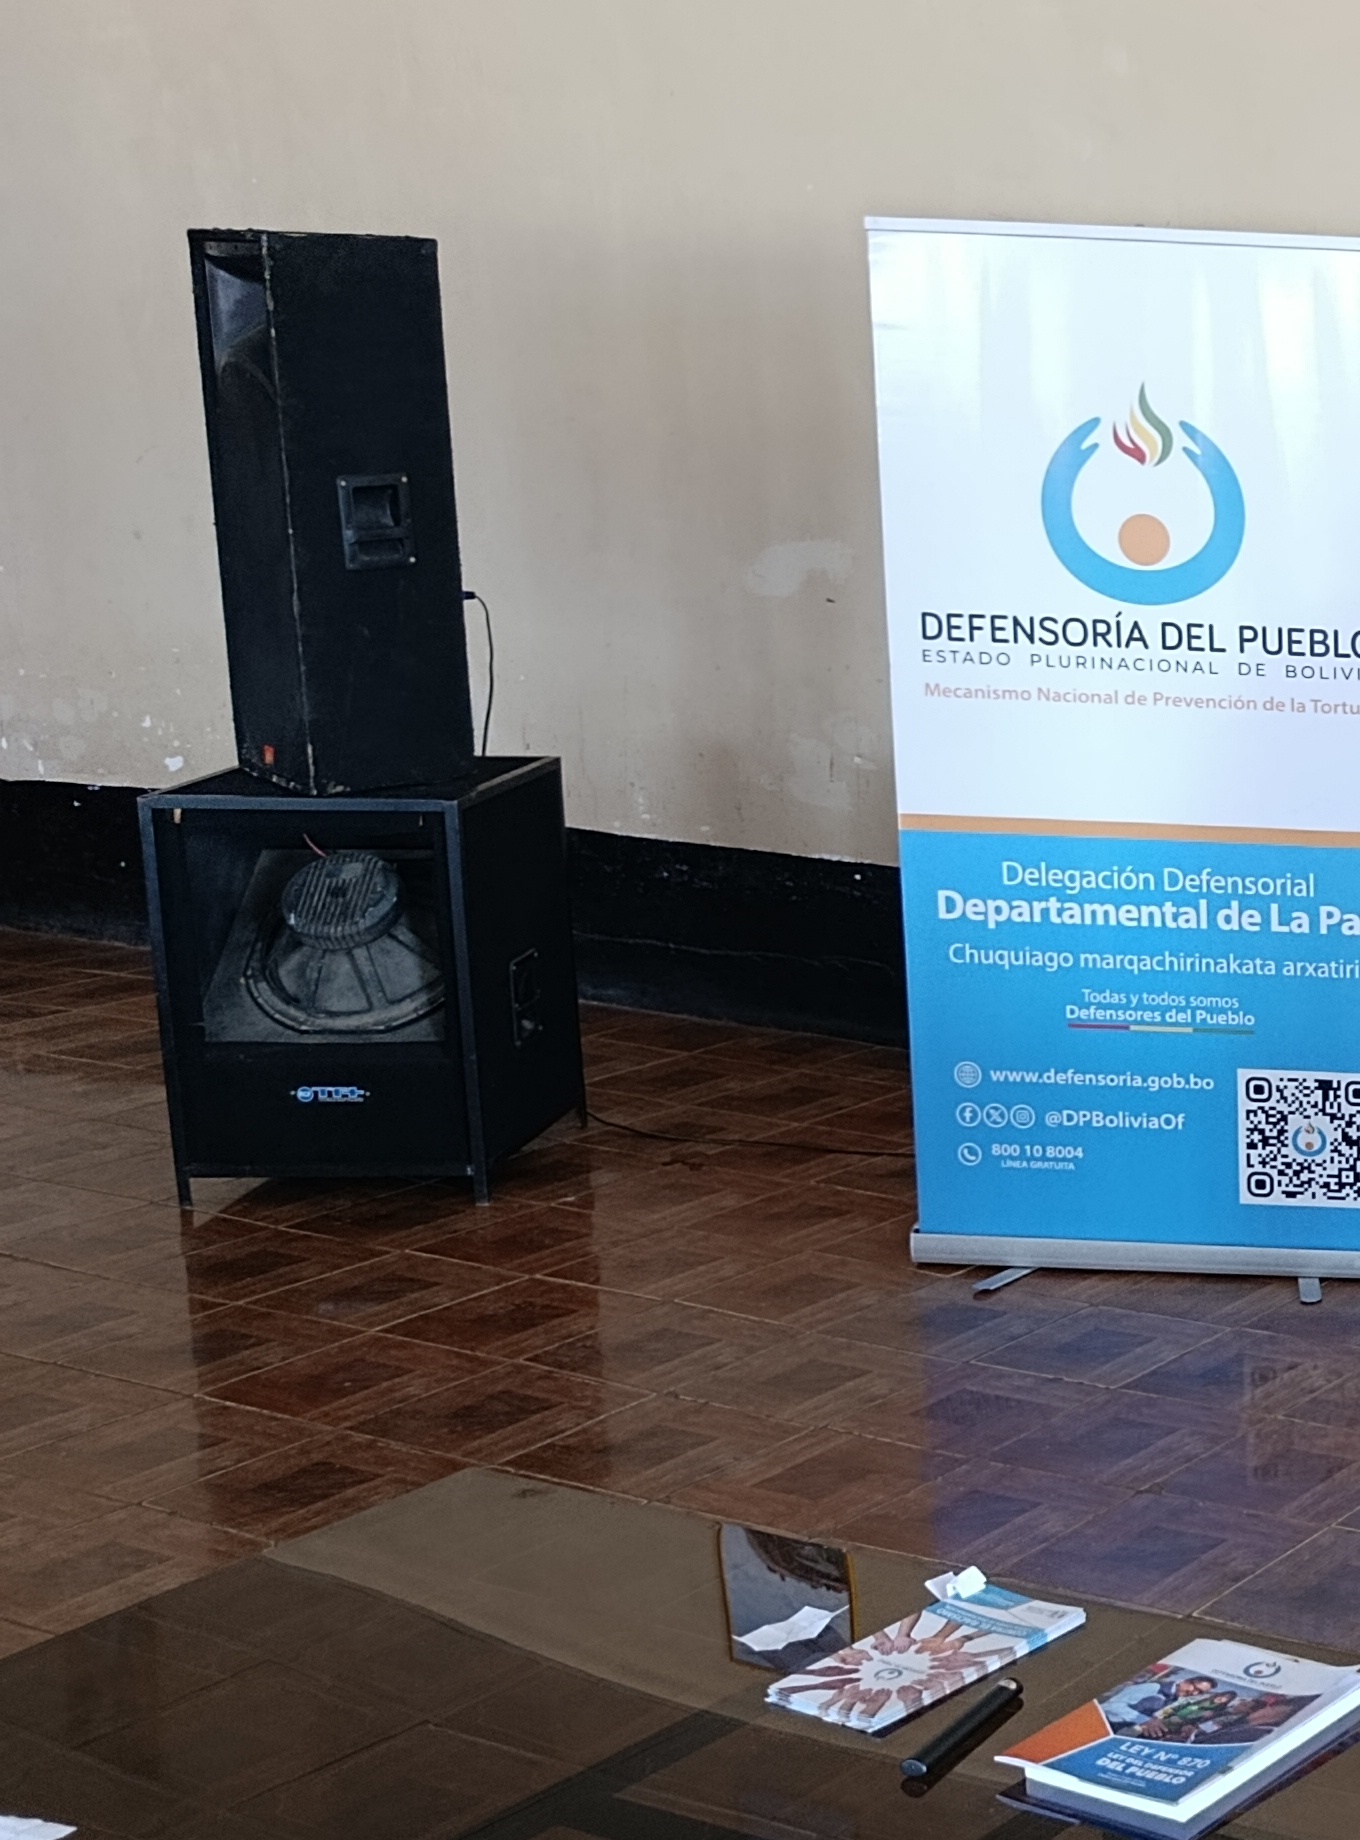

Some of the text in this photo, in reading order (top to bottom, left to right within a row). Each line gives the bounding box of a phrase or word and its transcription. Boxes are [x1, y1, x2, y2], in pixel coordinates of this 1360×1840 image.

[921, 611, 1149, 649] DEFENSORÍA
[1161, 621, 1227, 653] DEL
[922, 649, 1011, 666] ESTADO
[1030, 653, 1219, 675] PLURINACIONAL
[1238, 662, 1266, 677] DE
[924, 682, 1032, 701] Mecanismo
[1037, 687, 1118, 705] Nacional
[1124, 690, 1147, 706] de
[1153, 692, 1258, 711] Prevención
[1262, 697, 1286, 713] de
[1291, 698, 1306, 713] la
[1002, 861, 1314, 898] Delegación Defensorial
[937, 889, 1208, 930] Departamental
[1216, 899, 1262, 932] de
[1270, 903, 1310, 934] La
[949, 943, 1360, 979] Chuquiago marqachirinakata arxatiri
[1082, 988, 1239, 1009] Todas y todos somos
[1065, 1004, 1256, 1026] Defensores del Pueblo
[990, 1068, 1215, 1091] www.defensoria.gob.bo
[1045, 1110, 1185, 1130] @DPBoliviaOf
[991, 1143, 1084, 1159] 800 10 8004
[1029, 1160, 1076, 1171] GRATUITA
[1119, 1741, 1156, 1756] LEY
[1177, 1757, 1211, 1769] 870
[1095, 1757, 1126, 1771] DEL
[1125, 1766, 1187, 1785] PUEBLO
